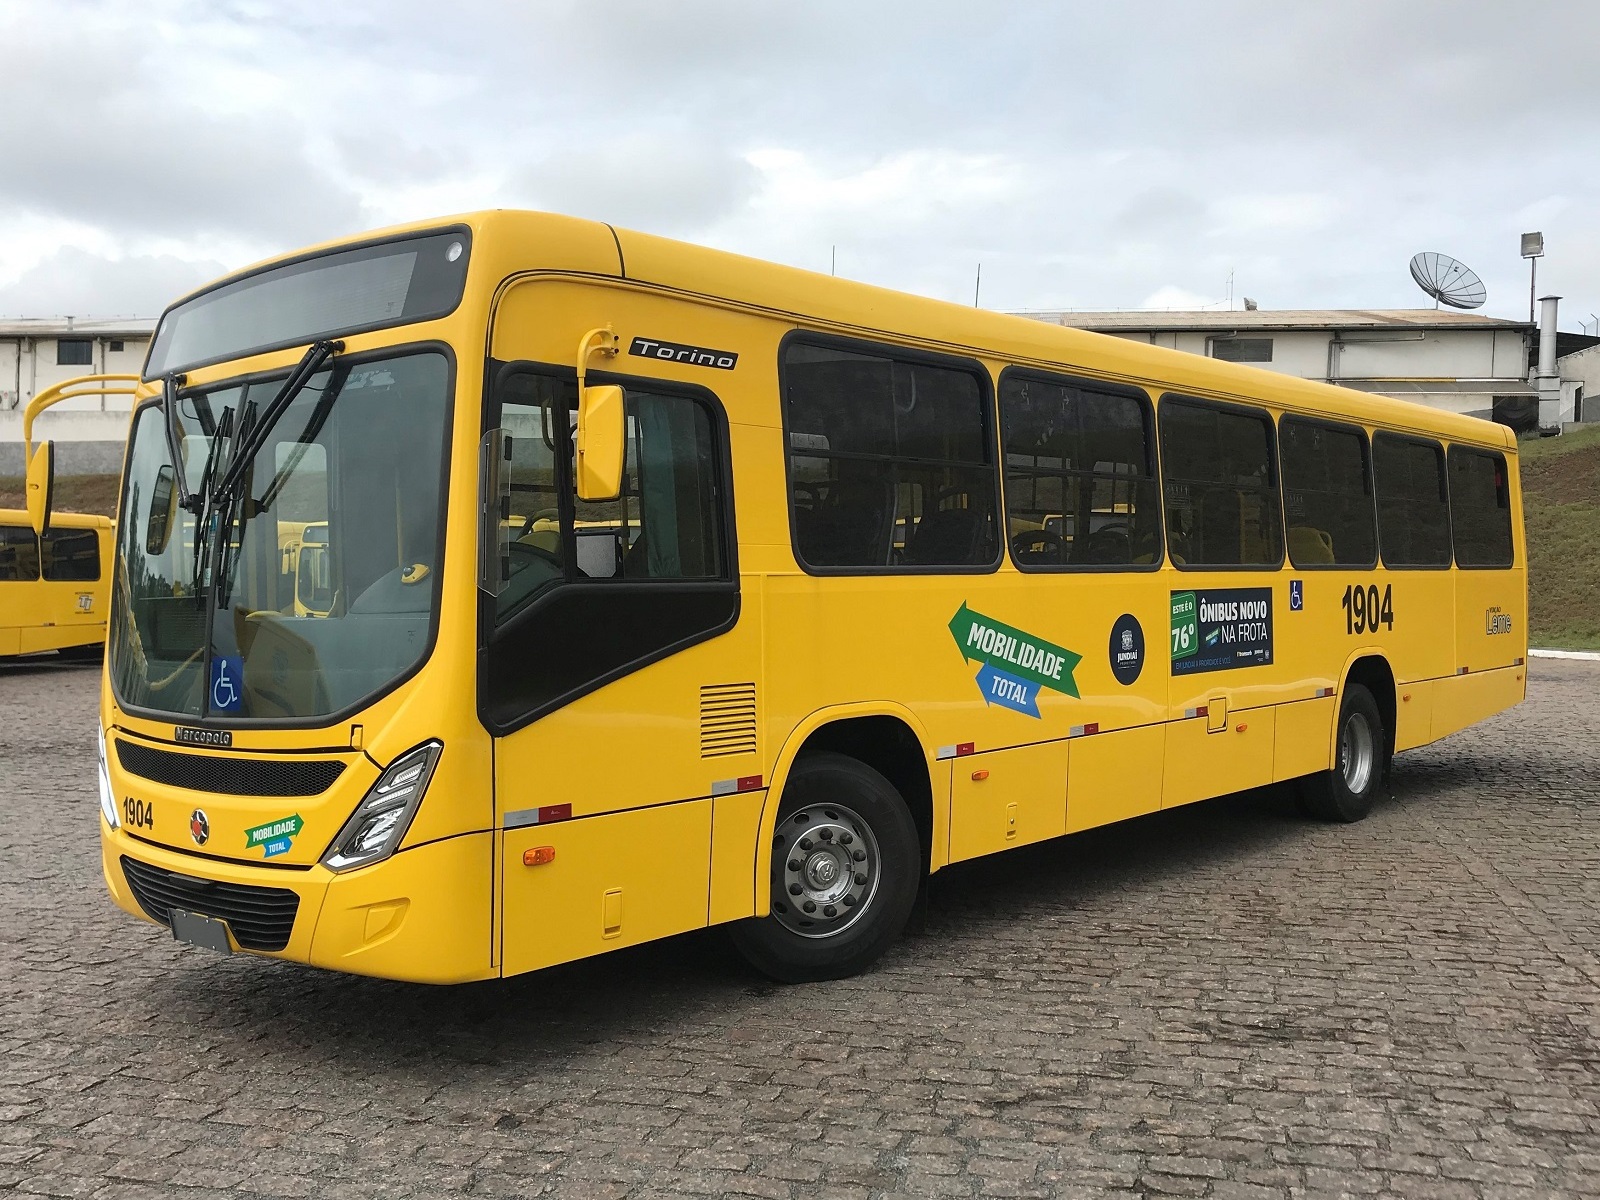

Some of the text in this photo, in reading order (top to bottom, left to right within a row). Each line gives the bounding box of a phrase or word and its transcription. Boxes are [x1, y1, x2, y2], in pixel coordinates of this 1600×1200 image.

[635, 340, 734, 368] Torino
[1172, 603, 1185, 614] ESTE
[1200, 597, 1267, 622] ÔNIBUS NOVO
[1342, 583, 1394, 635] 1904
[1221, 624, 1236, 644] NA
[1238, 622, 1268, 642] FROTA
[1486, 609, 1512, 635] Leme
[967, 622, 1065, 680] MOBILIDADE
[991, 675, 1027, 705] TOTAL
[176, 727, 230, 745] Marcopolo
[123, 796, 153, 830] 1904
[252, 819, 296, 842] MOBILIDADE
[268, 842, 286, 854] TOTAL
